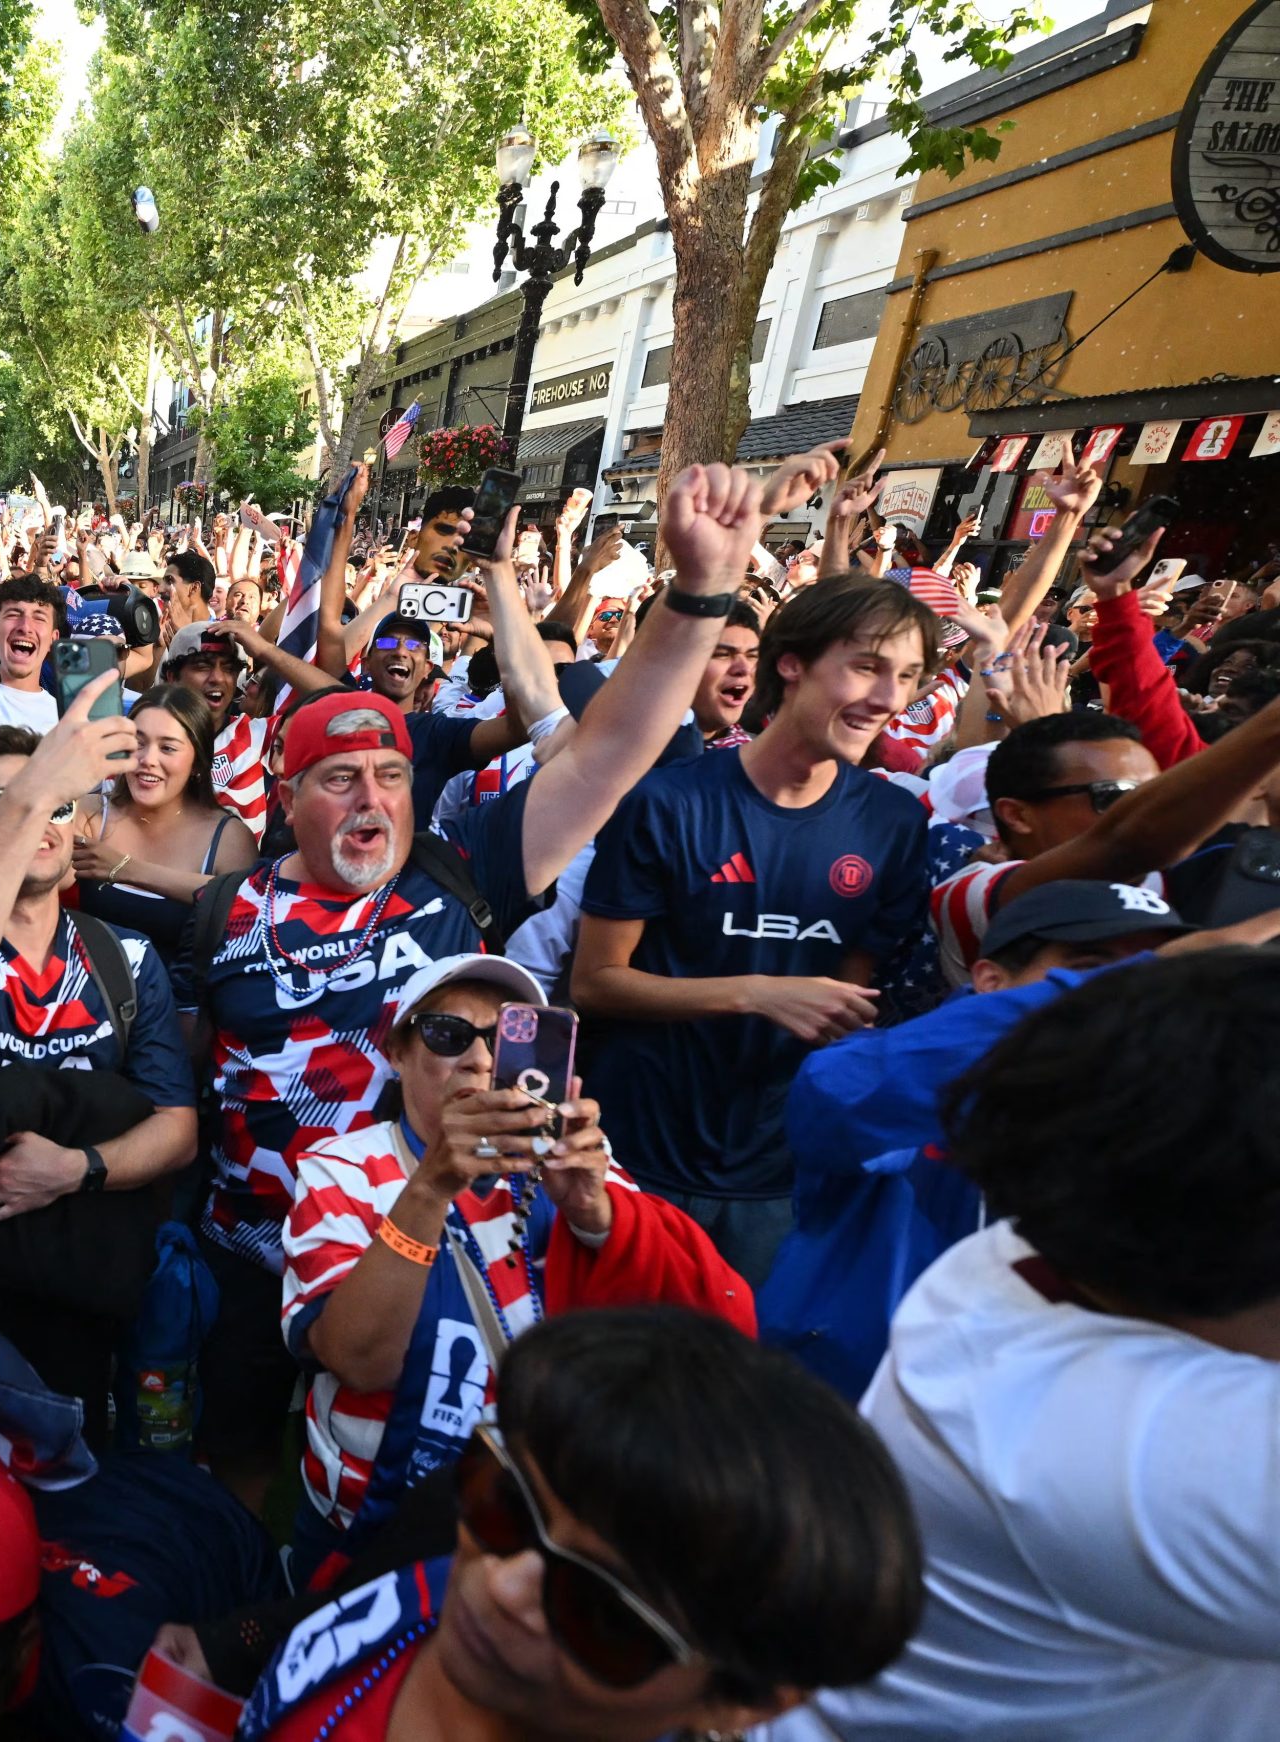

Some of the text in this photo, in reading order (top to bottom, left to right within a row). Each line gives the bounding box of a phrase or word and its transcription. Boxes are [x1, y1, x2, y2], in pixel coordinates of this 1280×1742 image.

[1222, 80, 1276, 112] THE
[531, 378, 585, 407] FIREHOUSE
[1147, 426, 1171, 439] STELLA
[1144, 441, 1168, 454] ARTOIS
[880, 487, 930, 515] CLASICO
[906, 700, 931, 712] USA
[276, 930, 435, 1010] USA
[47, 1034, 88, 1055] CUP
[432, 1407, 463, 1427] FIFA
